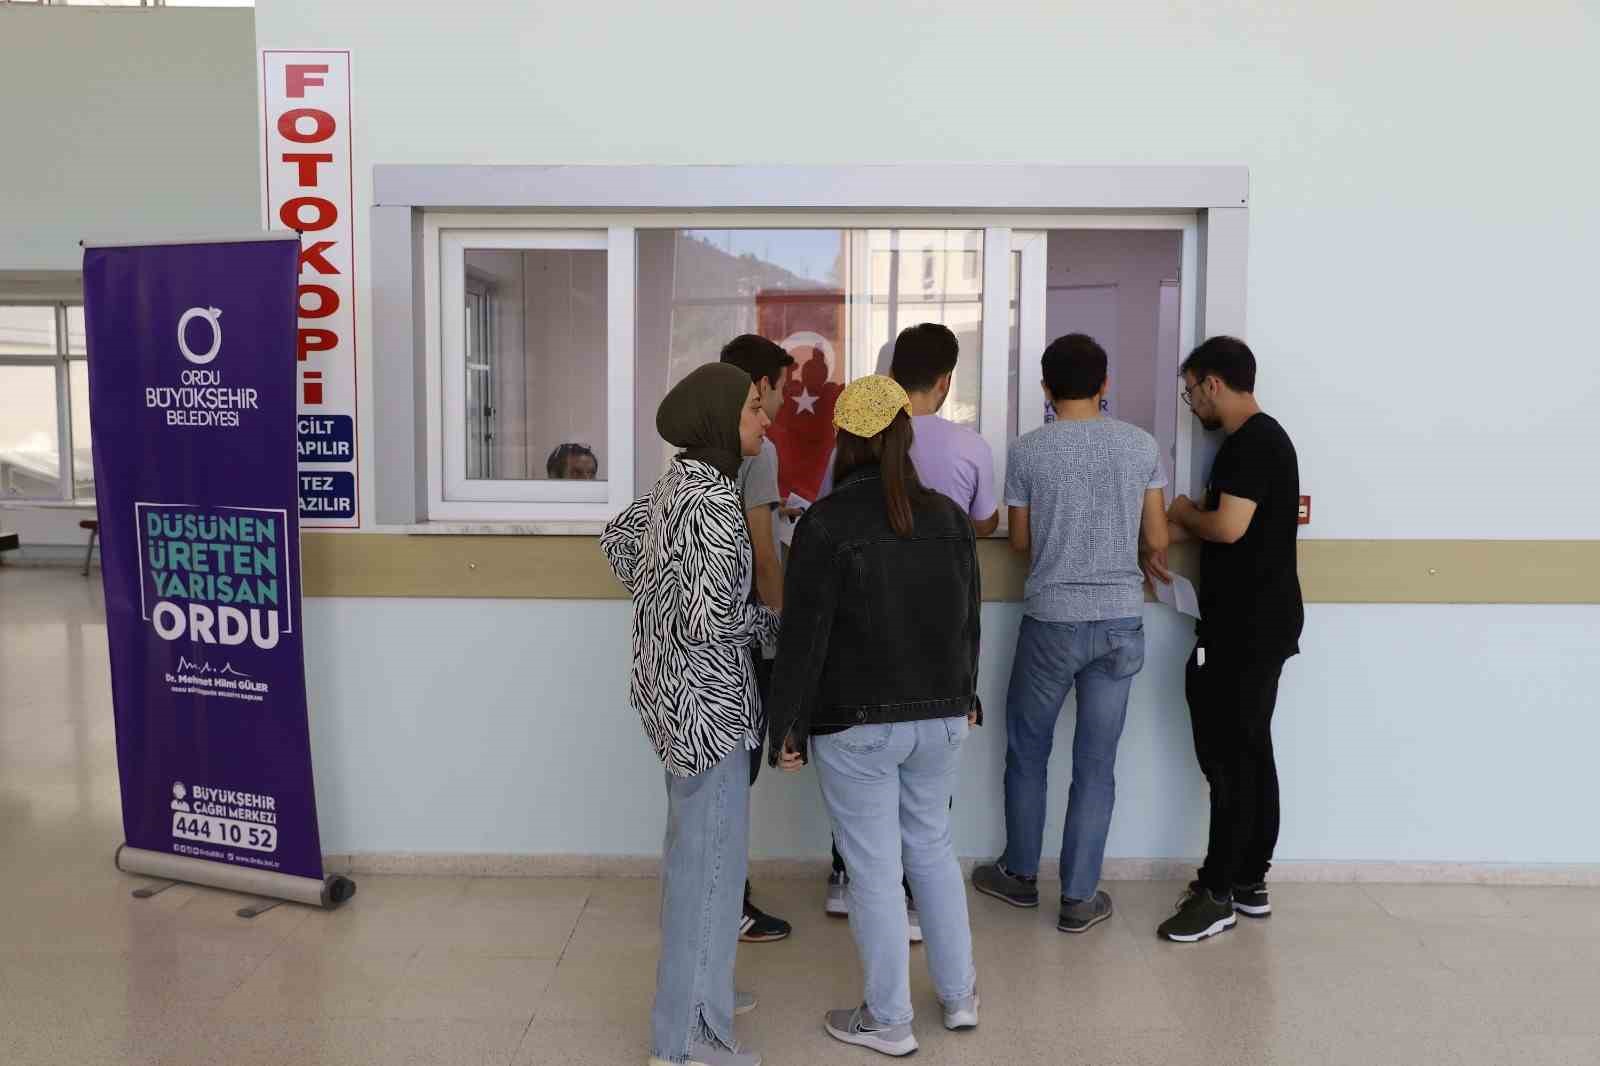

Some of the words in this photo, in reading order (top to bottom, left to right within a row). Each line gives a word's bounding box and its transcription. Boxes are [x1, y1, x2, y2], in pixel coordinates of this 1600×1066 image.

[277, 64, 341, 404] FOTOKOPİ
[181, 370, 220, 385] ORDU
[145, 387, 258, 409] BÜYÜKŞEHİR
[167, 410, 239, 426] BELEDİYESİ
[298, 416, 335, 434] CİLT
[297, 440, 350, 455] APILIR
[301, 477, 333, 490] TEZ
[299, 497, 350, 511] AZILIR
[147, 511, 275, 543] DÜŞÜNEN
[148, 540, 277, 576] ÜRETEN
[152, 600, 280, 650] ORDU
[238, 680, 268, 693] GÜLER
[192, 785, 275, 811] BÜYÜKŞEHİR
[193, 801, 227, 817] ÇAĞRI
[176, 816, 211, 839] 444
[219, 823, 241, 843] 10
[248, 827, 272, 848] 52
